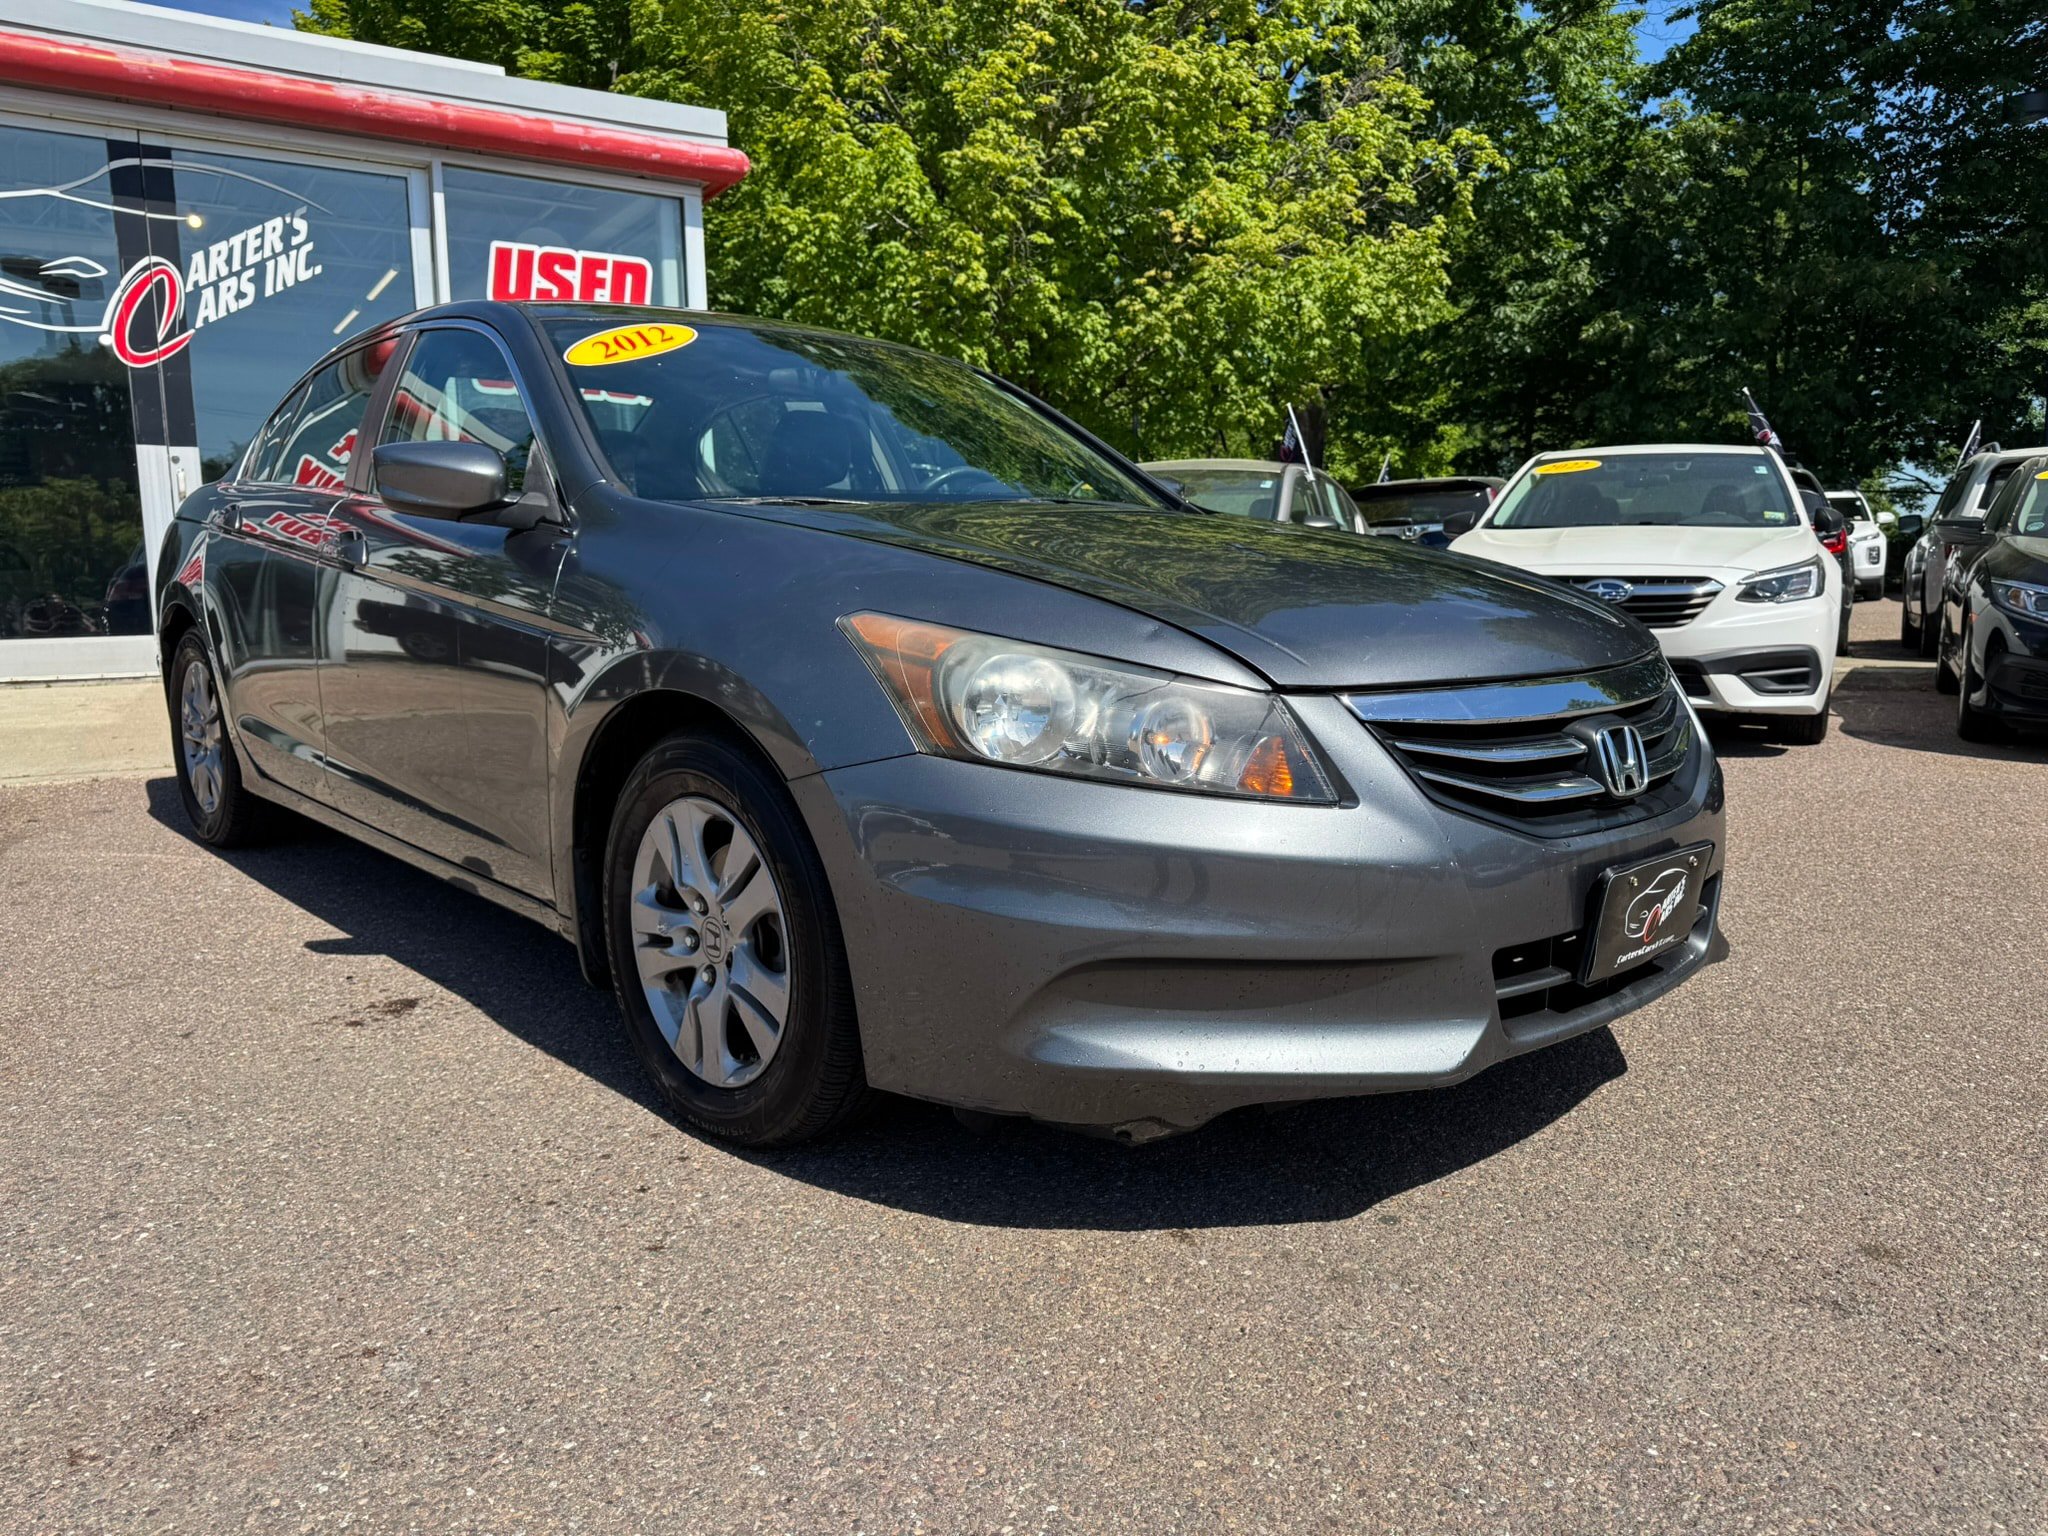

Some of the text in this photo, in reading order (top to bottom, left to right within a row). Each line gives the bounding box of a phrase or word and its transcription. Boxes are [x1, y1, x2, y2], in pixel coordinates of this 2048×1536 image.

[265, 242, 322, 297] INC.
[490, 244, 650, 304] USED
[591, 326, 674, 359] 2012
